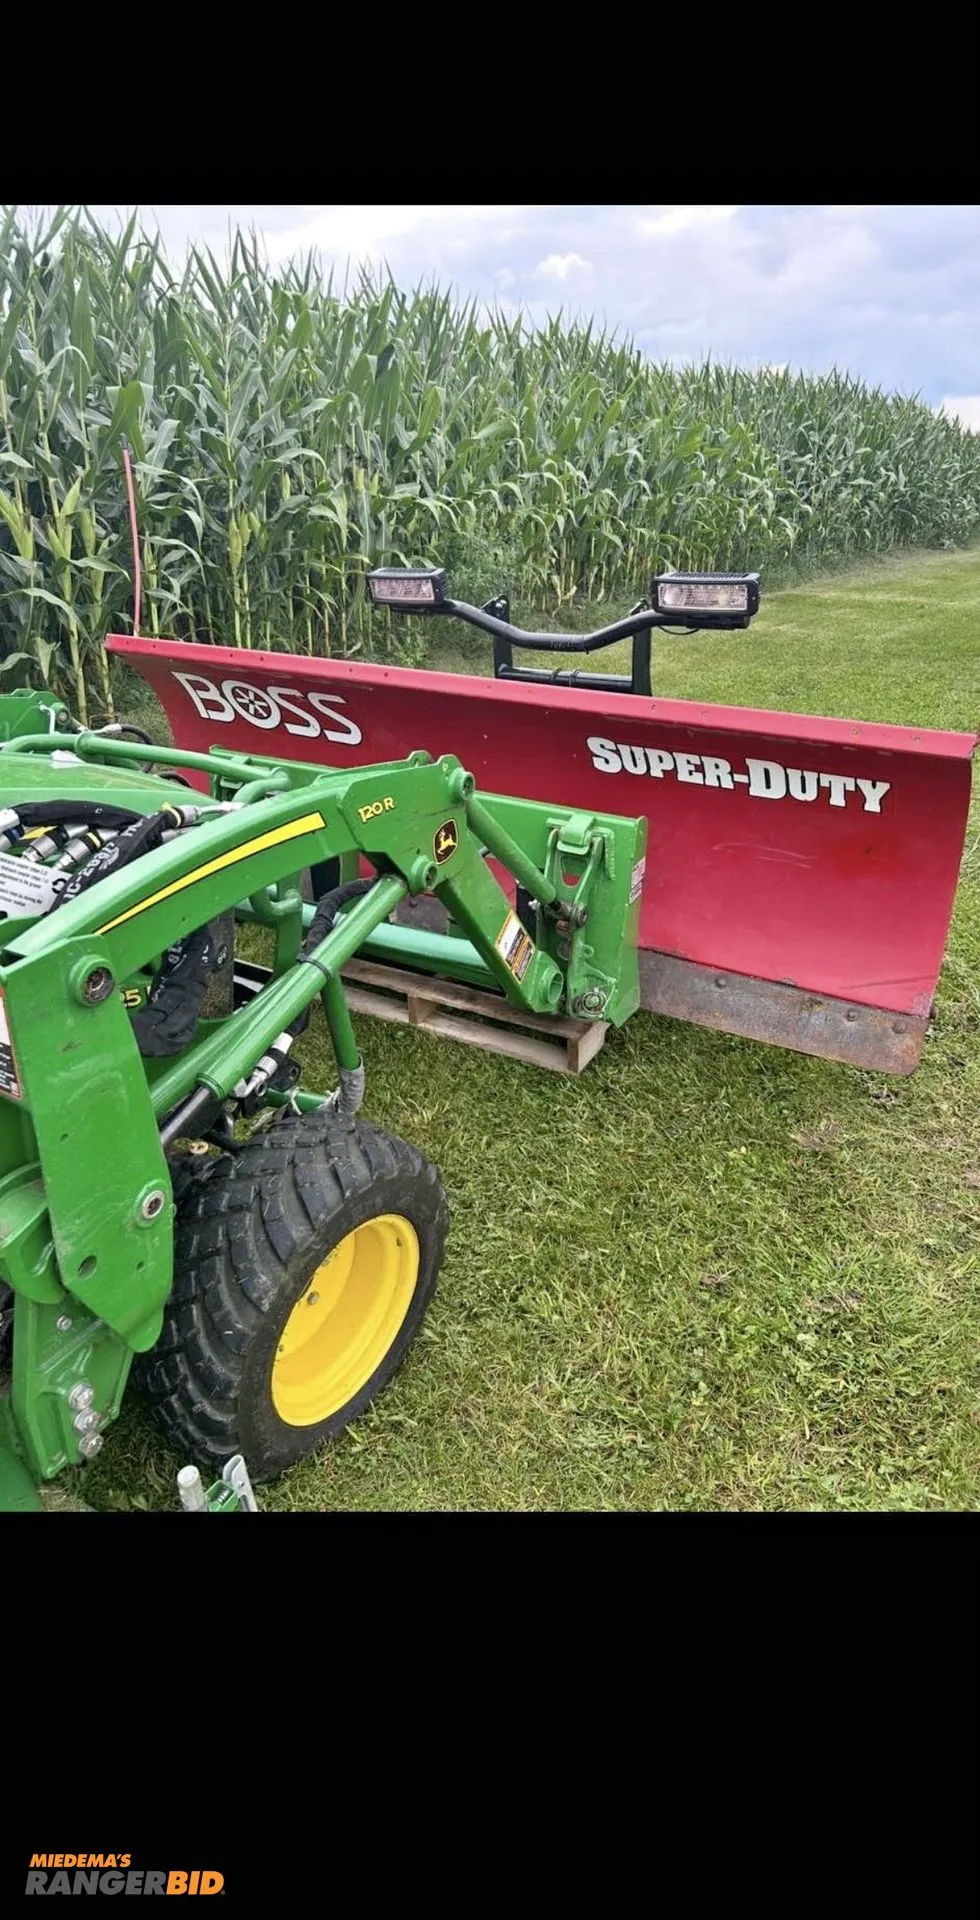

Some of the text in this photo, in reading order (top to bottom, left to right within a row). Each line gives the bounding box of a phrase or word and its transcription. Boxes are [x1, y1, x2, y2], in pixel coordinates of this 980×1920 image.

[170, 671, 362, 745] BOSS
[358, 797, 395, 823] 120 R
